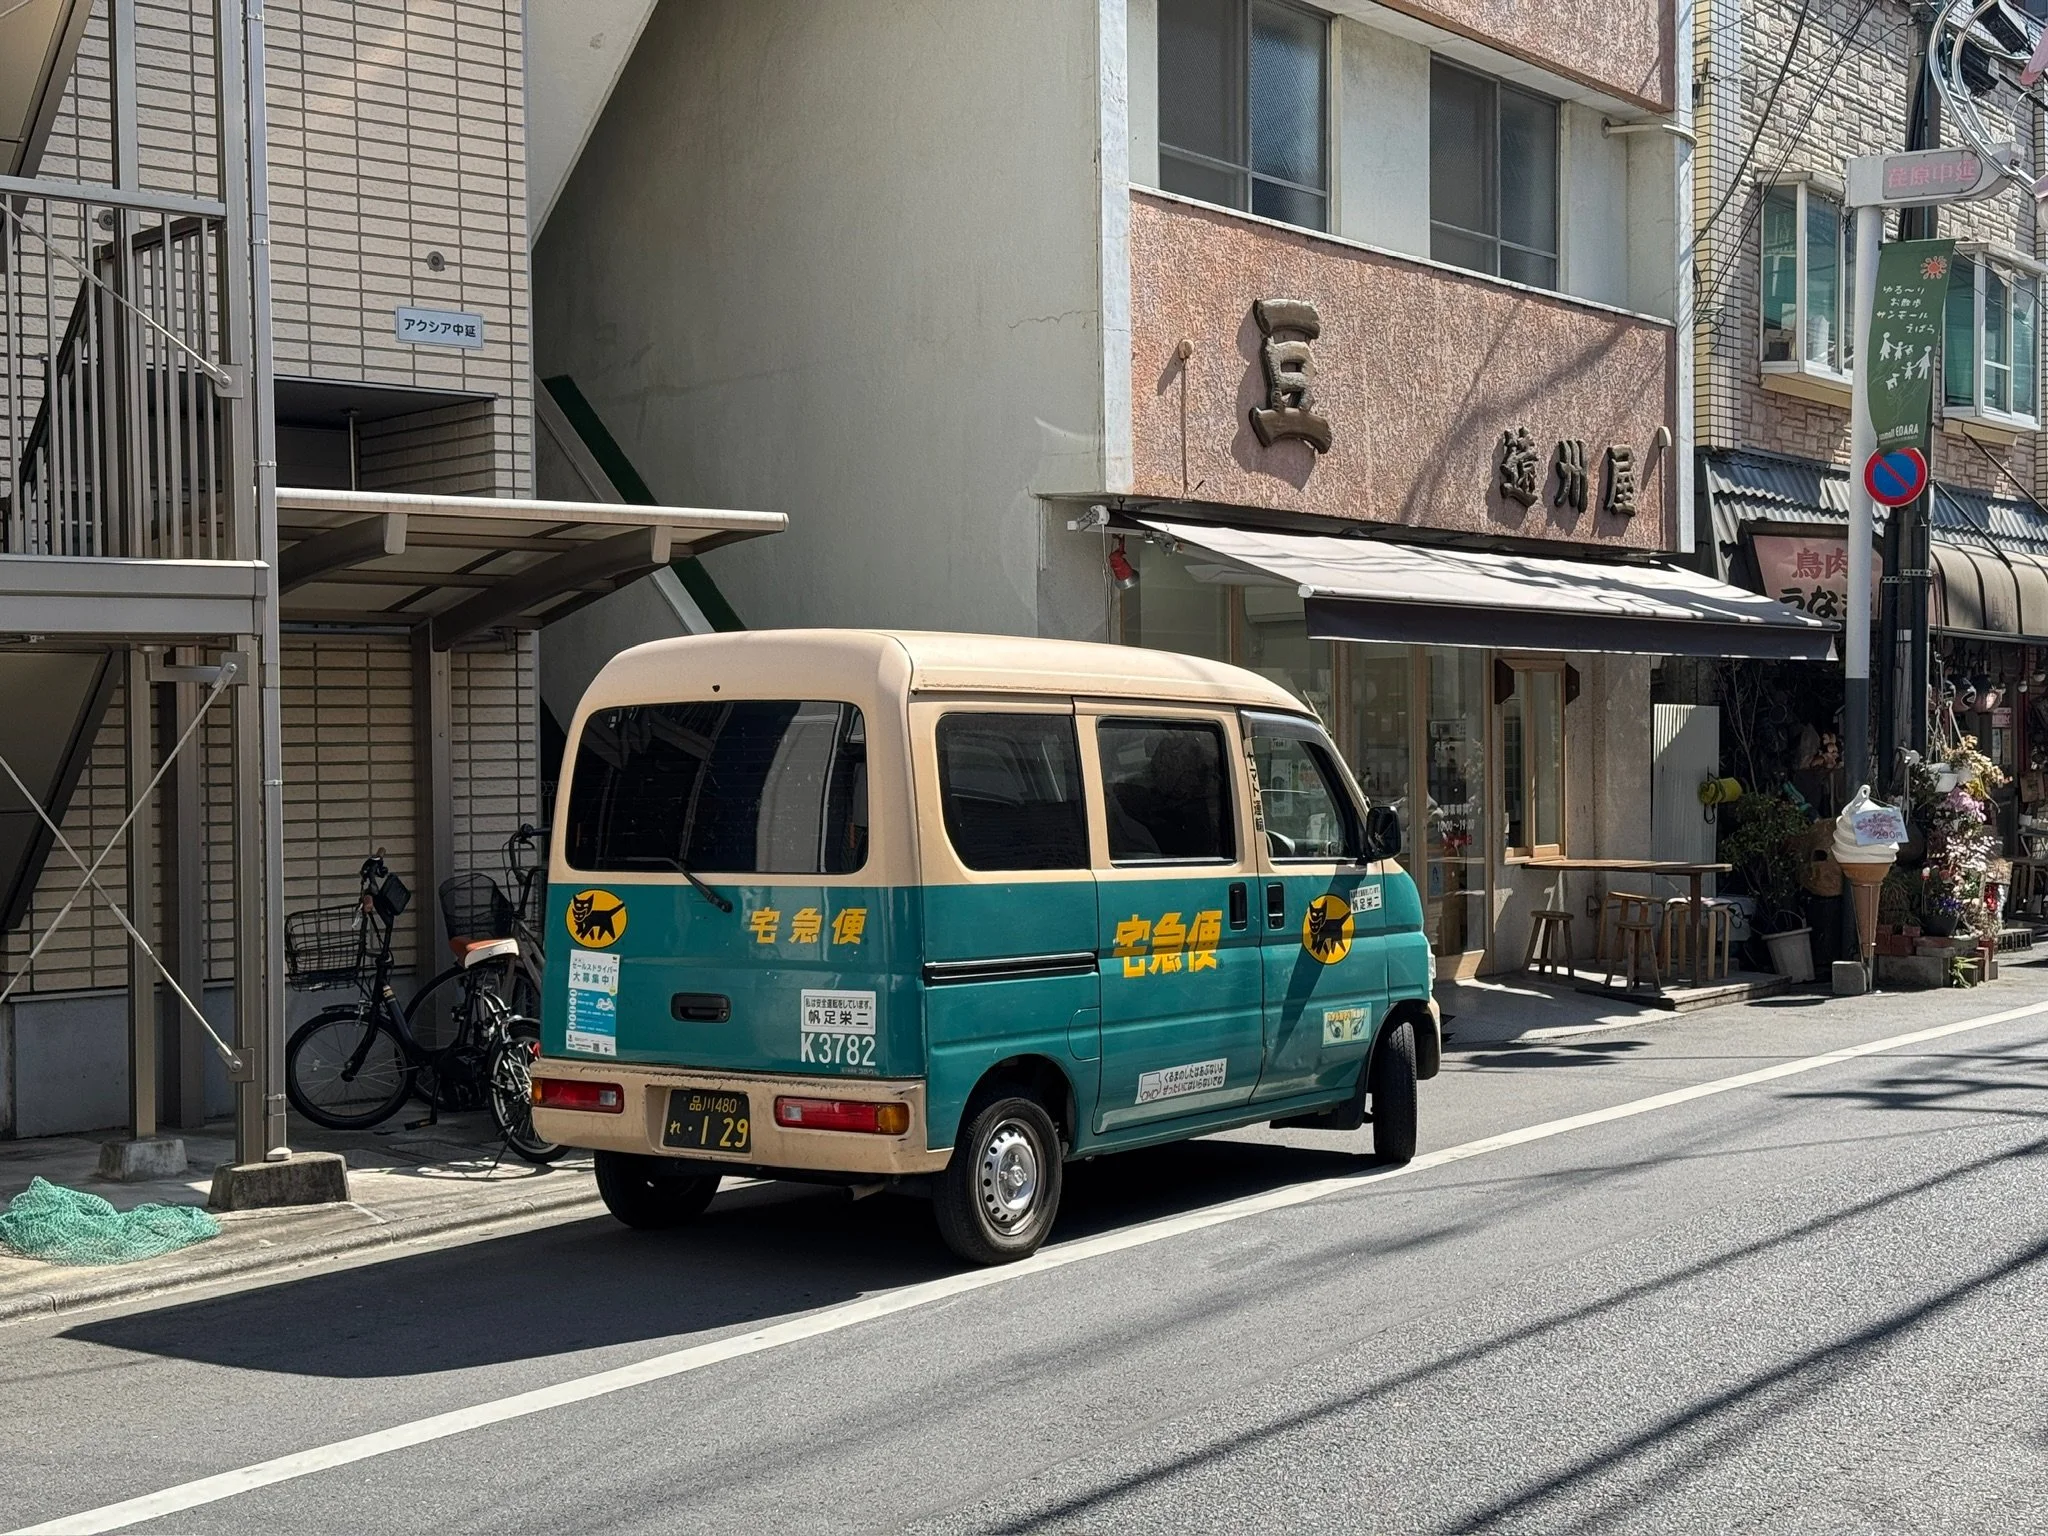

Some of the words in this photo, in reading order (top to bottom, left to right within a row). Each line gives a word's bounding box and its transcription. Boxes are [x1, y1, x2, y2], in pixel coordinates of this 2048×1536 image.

[1887, 160, 1976, 188] 荏原中延
[1890, 297, 1922, 308] お散歩
[1876, 310, 1929, 320] サンモール
[403, 318, 477, 338] アクシア中延
[1905, 323, 1935, 334] えばら
[1499, 426, 1636, 517] 遠州屋
[1779, 585, 1849, 619] うな
[749, 906, 868, 945] 宅急便
[1112, 910, 1223, 978] 宅急便
[808, 1009, 869, 1026] 帆足栄二
[800, 1032, 876, 1067] K3782
[688, 1095, 738, 1114] 品川480
